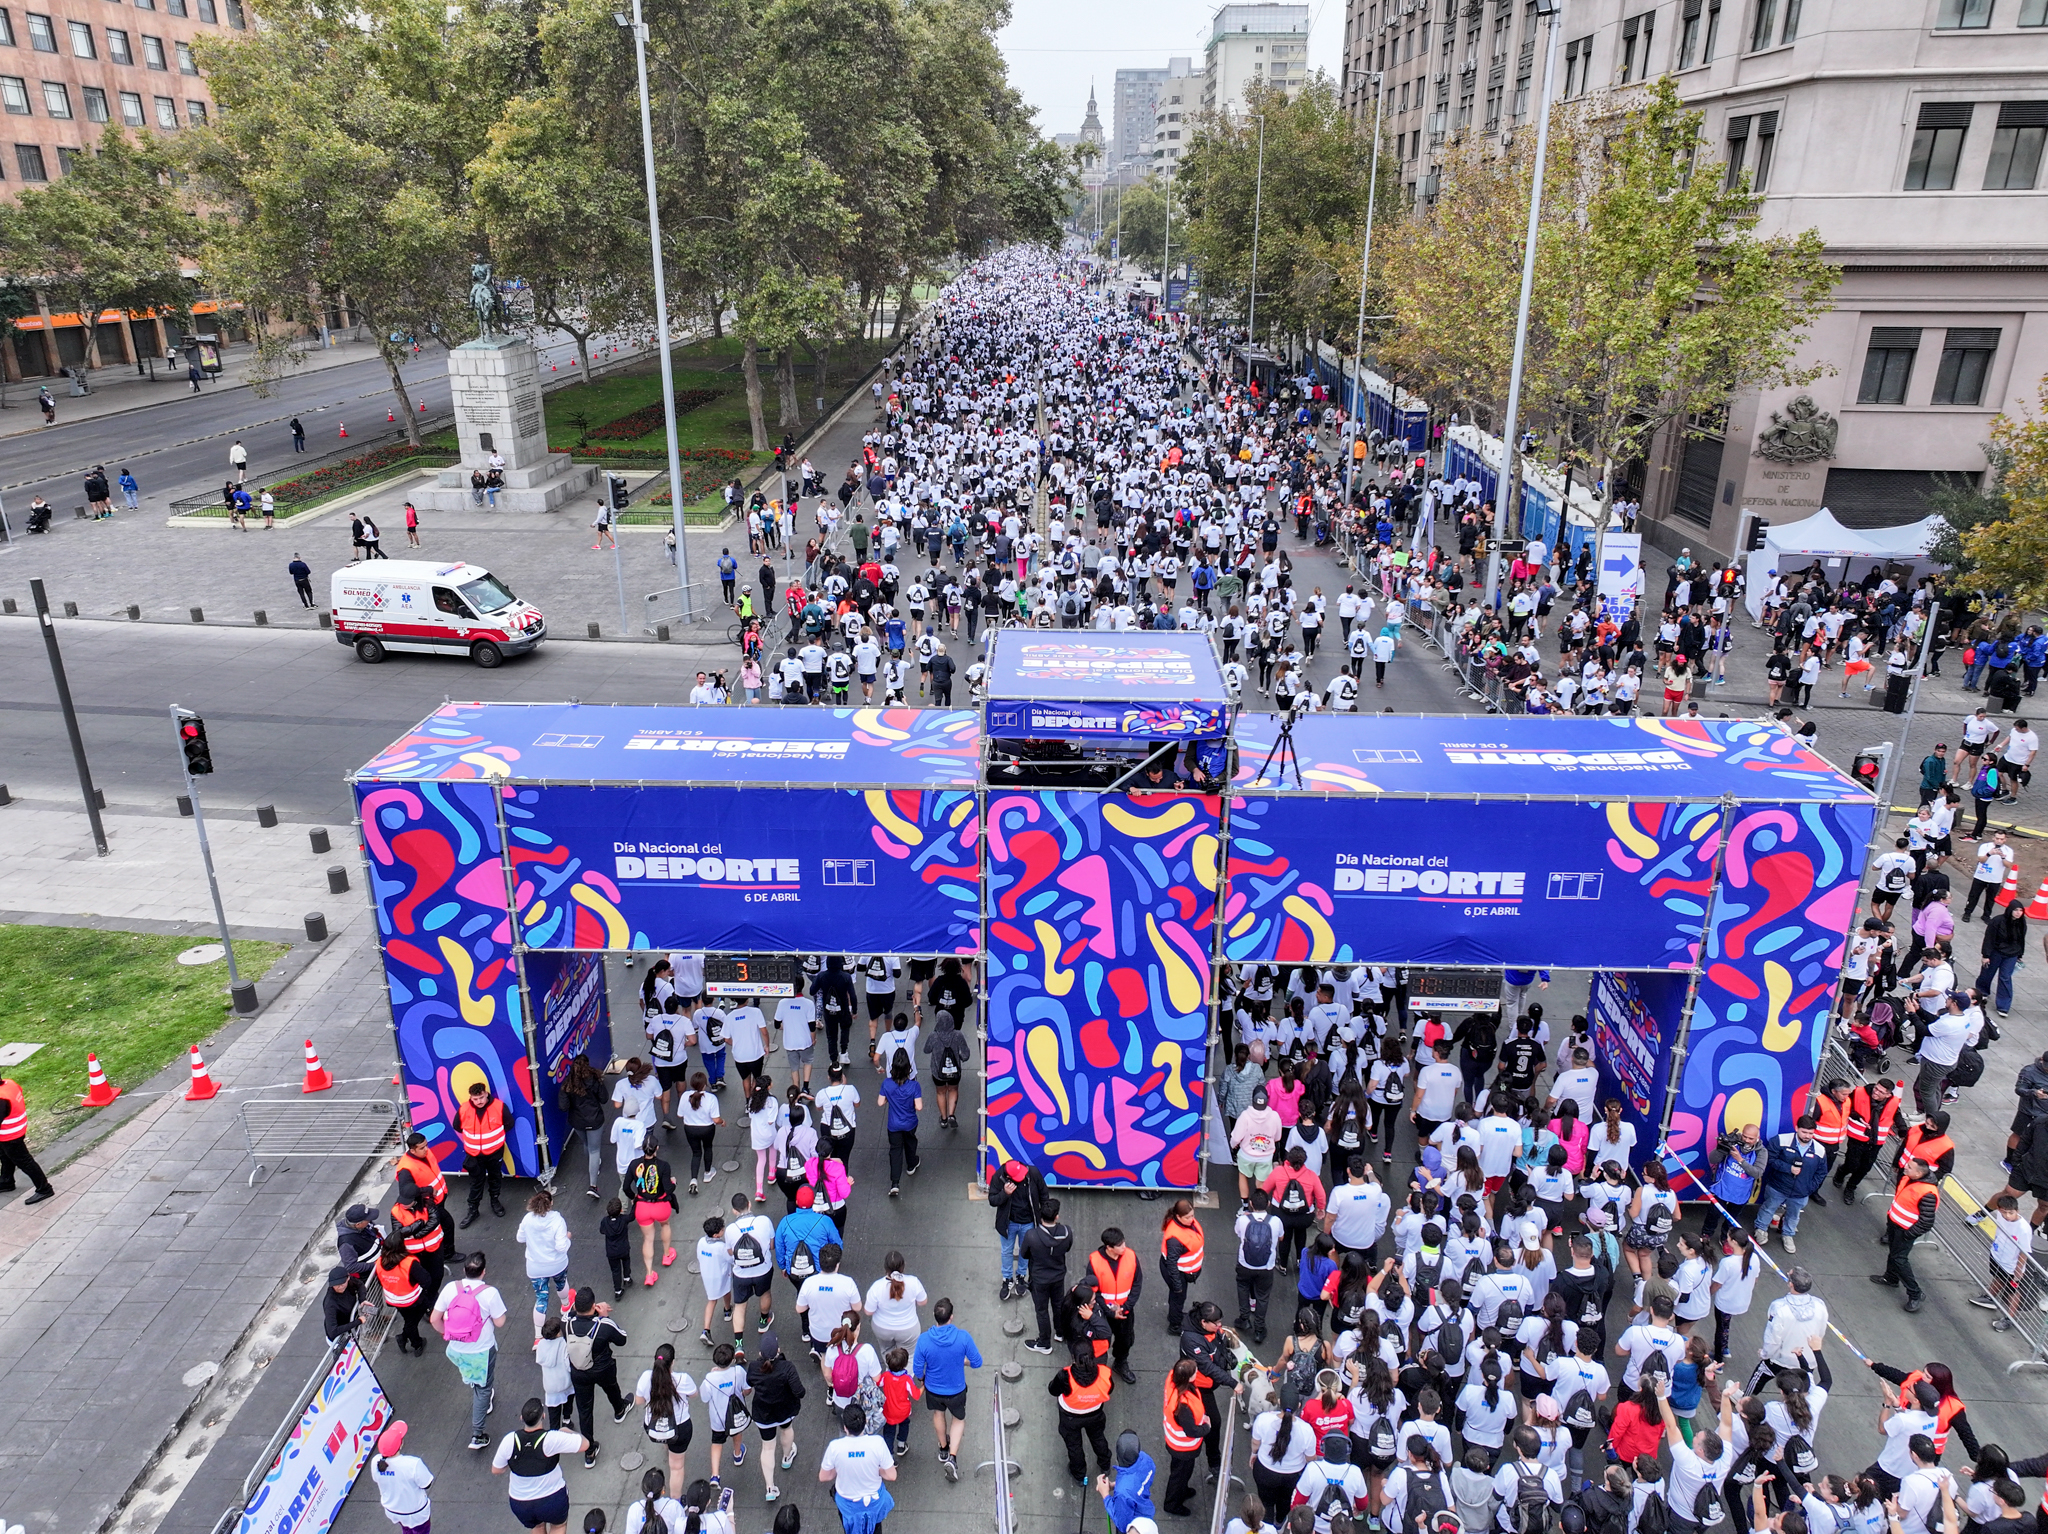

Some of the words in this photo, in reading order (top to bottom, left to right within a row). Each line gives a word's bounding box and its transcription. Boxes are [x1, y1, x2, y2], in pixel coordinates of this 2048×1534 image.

[1762, 471, 1811, 480] MINISTERIO
[1777, 485, 1790, 493] DE
[1741, 497, 1777, 506] DEFENSA
[1781, 498, 1821, 507] NACIONAL
[1609, 606, 1630, 614] OR
[1022, 659, 1192, 669] DEPORTE
[1031, 717, 1117, 729] DEPORTE
[623, 738, 850, 753] DEPORTE
[712, 751, 738, 759] del
[740, 751, 814, 760] Nacional
[1445, 750, 1685, 765] DEPORTE
[1550, 764, 1578, 772] del
[1580, 764, 1659, 772] Nacional
[1661, 762, 1693, 771] Día
[613, 842, 636, 854] Día
[639, 842, 699, 854] Nacional
[701, 843, 723, 855] del
[1335, 853, 1360, 866] Día
[1362, 854, 1425, 867] Nacional
[1426, 855, 1449, 868] del
[615, 857, 801, 882] DEPORTE
[1333, 868, 1526, 895] DEPORTE
[744, 893, 752, 903] 6
[753, 893, 769, 903] DE
[770, 892, 801, 902] ABRIL
[1463, 906, 1472, 917] 6
[1472, 907, 1489, 917] DE
[1490, 907, 1521, 917] ABRIL
[736, 962, 748, 981] 3
[545, 962, 599, 1057] DEPORTE
[1597, 979, 1656, 1078] DEPORTE
[1516, 1056, 1529, 1072] 9
[1579, 1371, 1593, 1379] RM
[1326, 1477, 1344, 1487] RM
[310, 1506, 318, 1517] DE
[316, 1486, 329, 1506] ABRIL
[274, 1504, 285, 1522] del
[1867, 1517, 1878, 1525] RM
